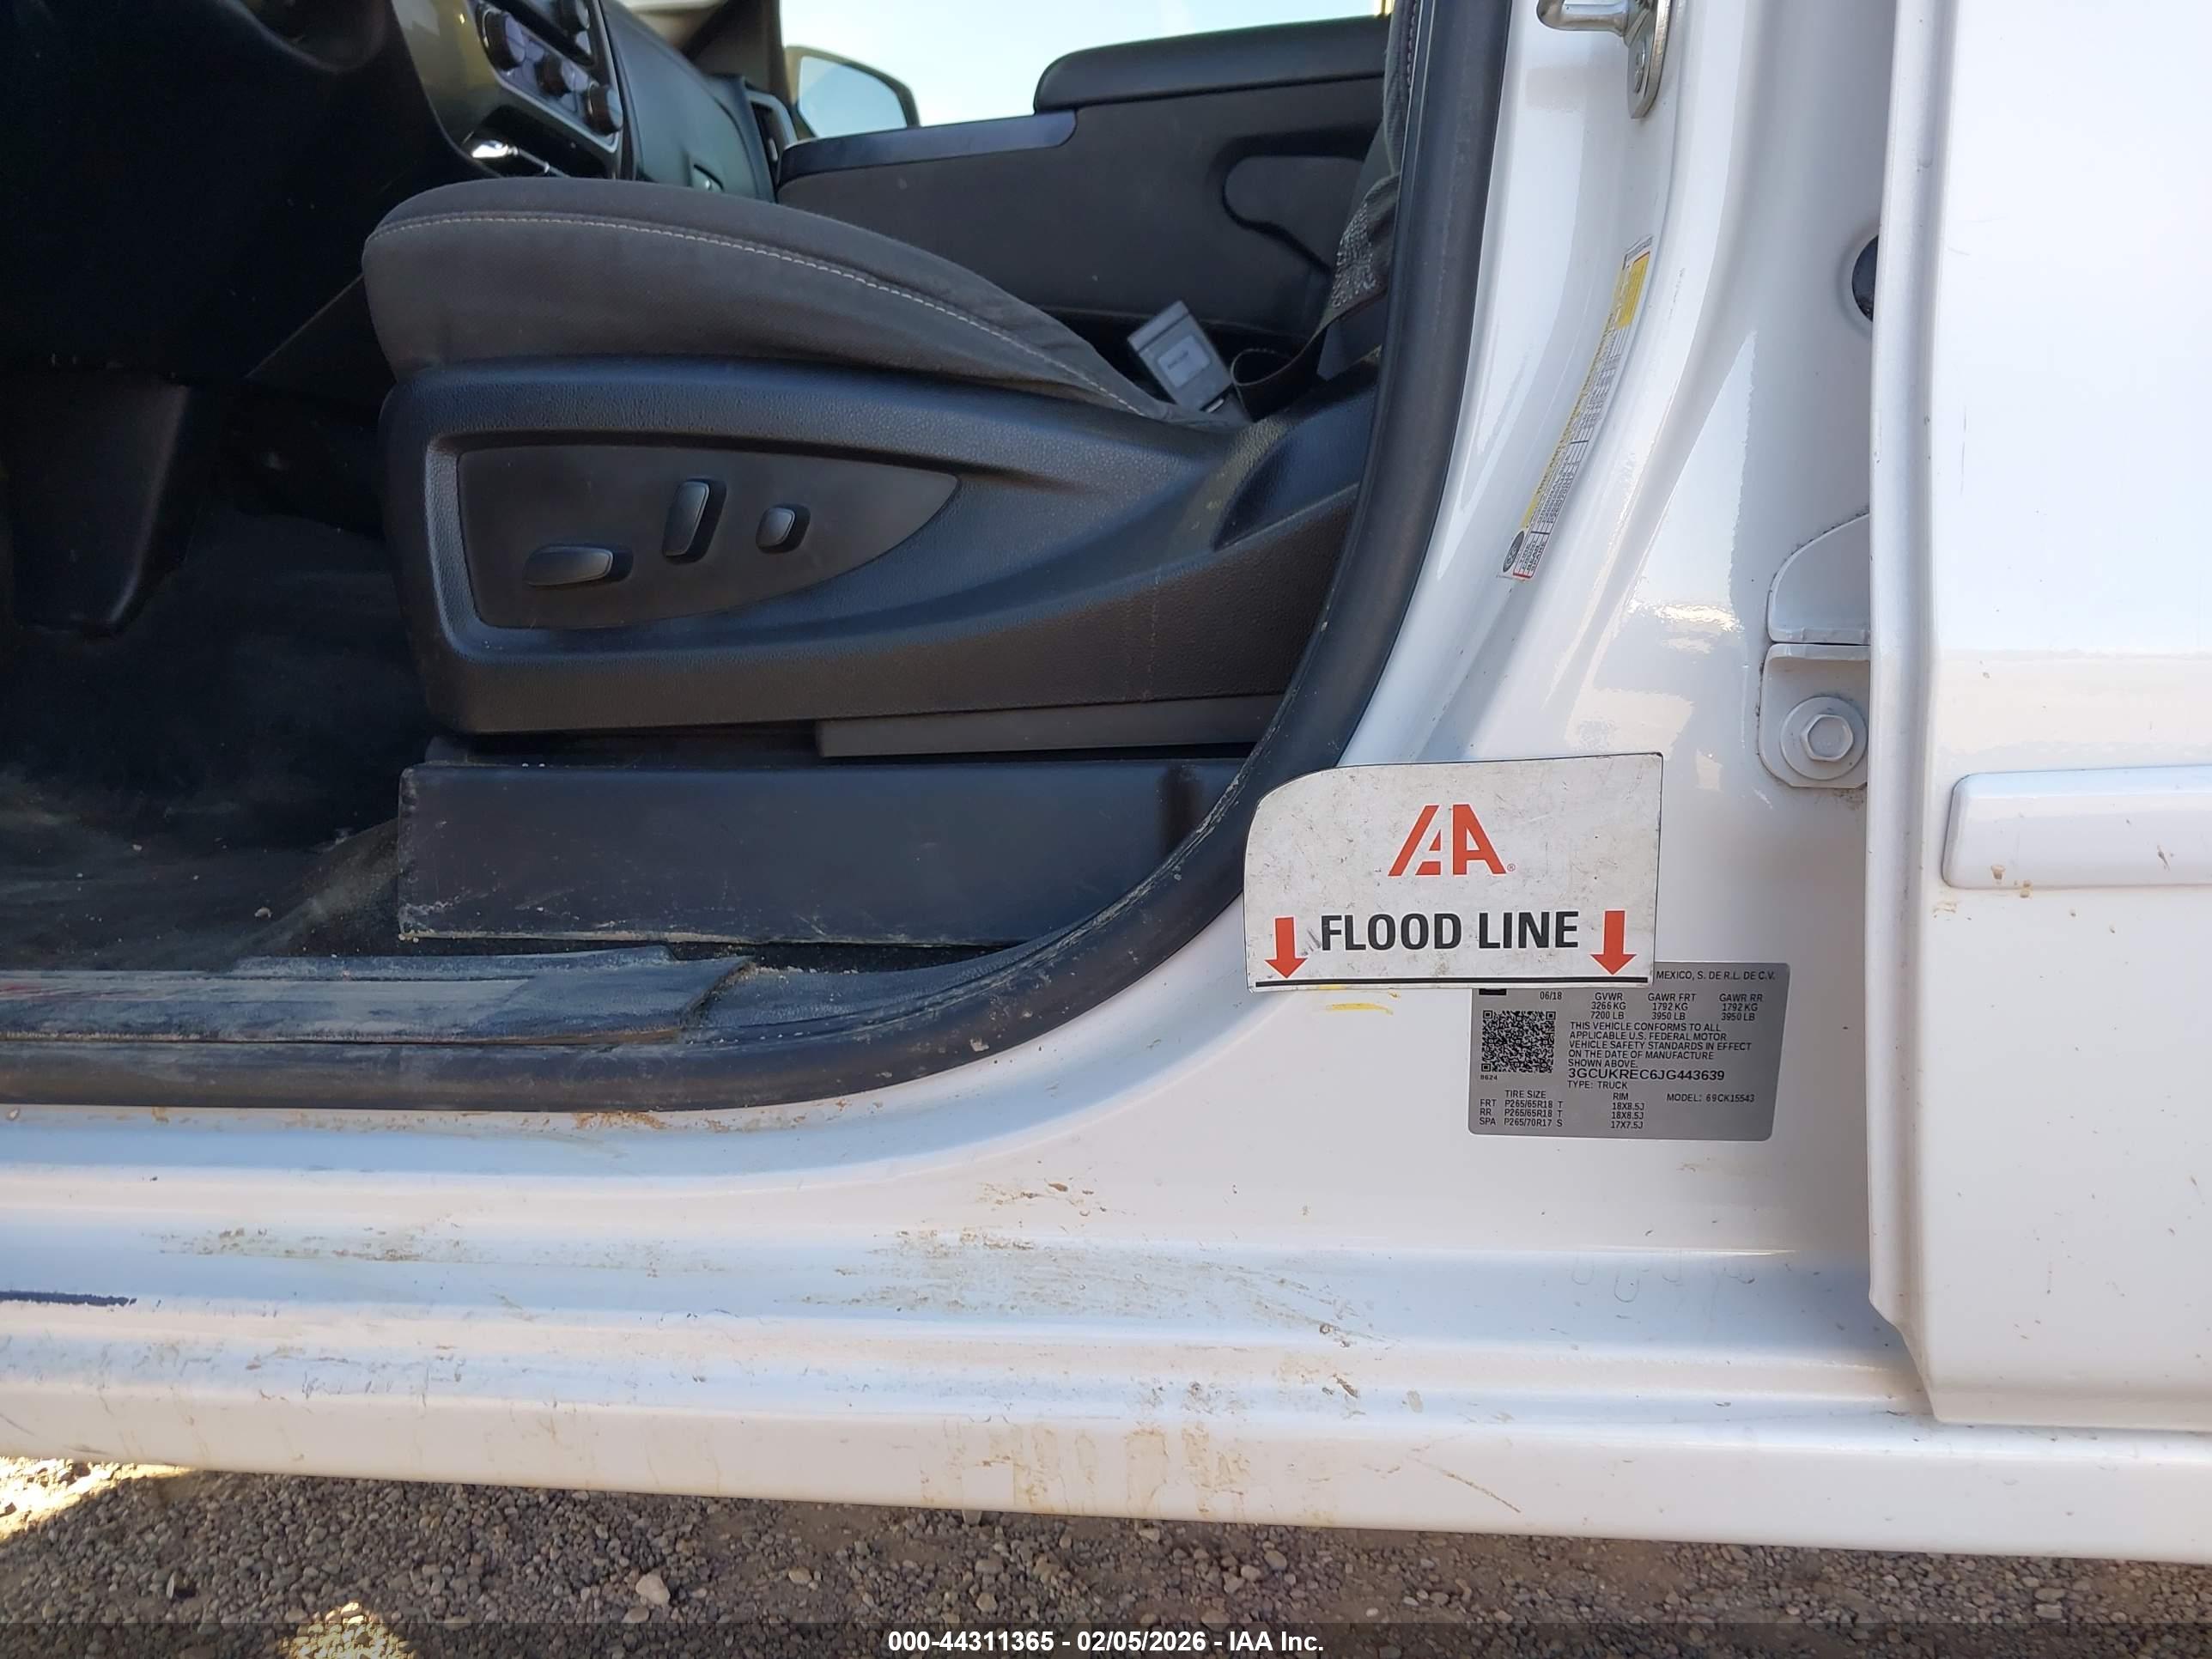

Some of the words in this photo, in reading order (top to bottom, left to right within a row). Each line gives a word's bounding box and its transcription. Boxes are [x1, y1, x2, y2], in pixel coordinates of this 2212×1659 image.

[1321, 913, 1461, 951] FLOOD
[1478, 910, 1579, 949] LINE
[1656, 970, 1695, 981] MEXICO,
[1697, 971, 1706, 980] S.
[1709, 971, 1722, 980] DE
[1723, 971, 1740, 980] R.L.
[1743, 971, 1756, 980] DE
[1759, 971, 1776, 980] C.V.
[1540, 991, 1563, 1000] 06/18
[1595, 992, 1624, 1000] GVWR
[1647, 993, 1675, 1001] GAWR
[1678, 993, 1697, 1001] FRT
[1719, 994, 1747, 1002] GAWR
[1749, 994, 1764, 1002] RR
[1591, 1001, 1612, 1010] 3266
[1613, 1001, 1626, 1010] KG
[1722, 1003, 1742, 1012] 1792
[1744, 1003, 1758, 1012] KG
[1590, 1011, 1610, 1019] 7200
[1613, 1012, 1625, 1020] LB
[1651, 1012, 1671, 1020] 3950
[1721, 1012, 1741, 1021] 3950
[1593, 1022, 1632, 1030] VEHICLE
[1634, 1022, 1686, 1030] CONFORMS
[1570, 1031, 1626, 1040] APPLICABLE
[1648, 1042, 1703, 1050] STANDARDS
[1717, 1042, 1752, 1051] EFFECT
[1568, 1049, 1582, 1058] ON
[1604, 1050, 1628, 1059] DATE
[1630, 1050, 1643, 1059] OF
[1645, 1050, 1715, 1060] MANUFACTURE
[1604, 1060, 1638, 1068] ABOVE.
[1568, 1067, 1725, 1080] 3GCUKREC6JG443639
[1567, 1080, 1594, 1089] TYPE:
[1597, 1081, 1628, 1090] TRUCK
[1504, 1090, 1524, 1098] TIRE
[1666, 1093, 1702, 1102] MODEL:
[1705, 1094, 1755, 1103] 69CK15543
[1612, 1102, 1644, 1110] 18X8.5J
[1504, 1109, 1553, 1117] P265/65R18
[1612, 1111, 1644, 1120] 18X8.5J
[1504, 1118, 1552, 1127] P265/70R17
[1610, 1121, 1644, 1129] 17X7.5J
